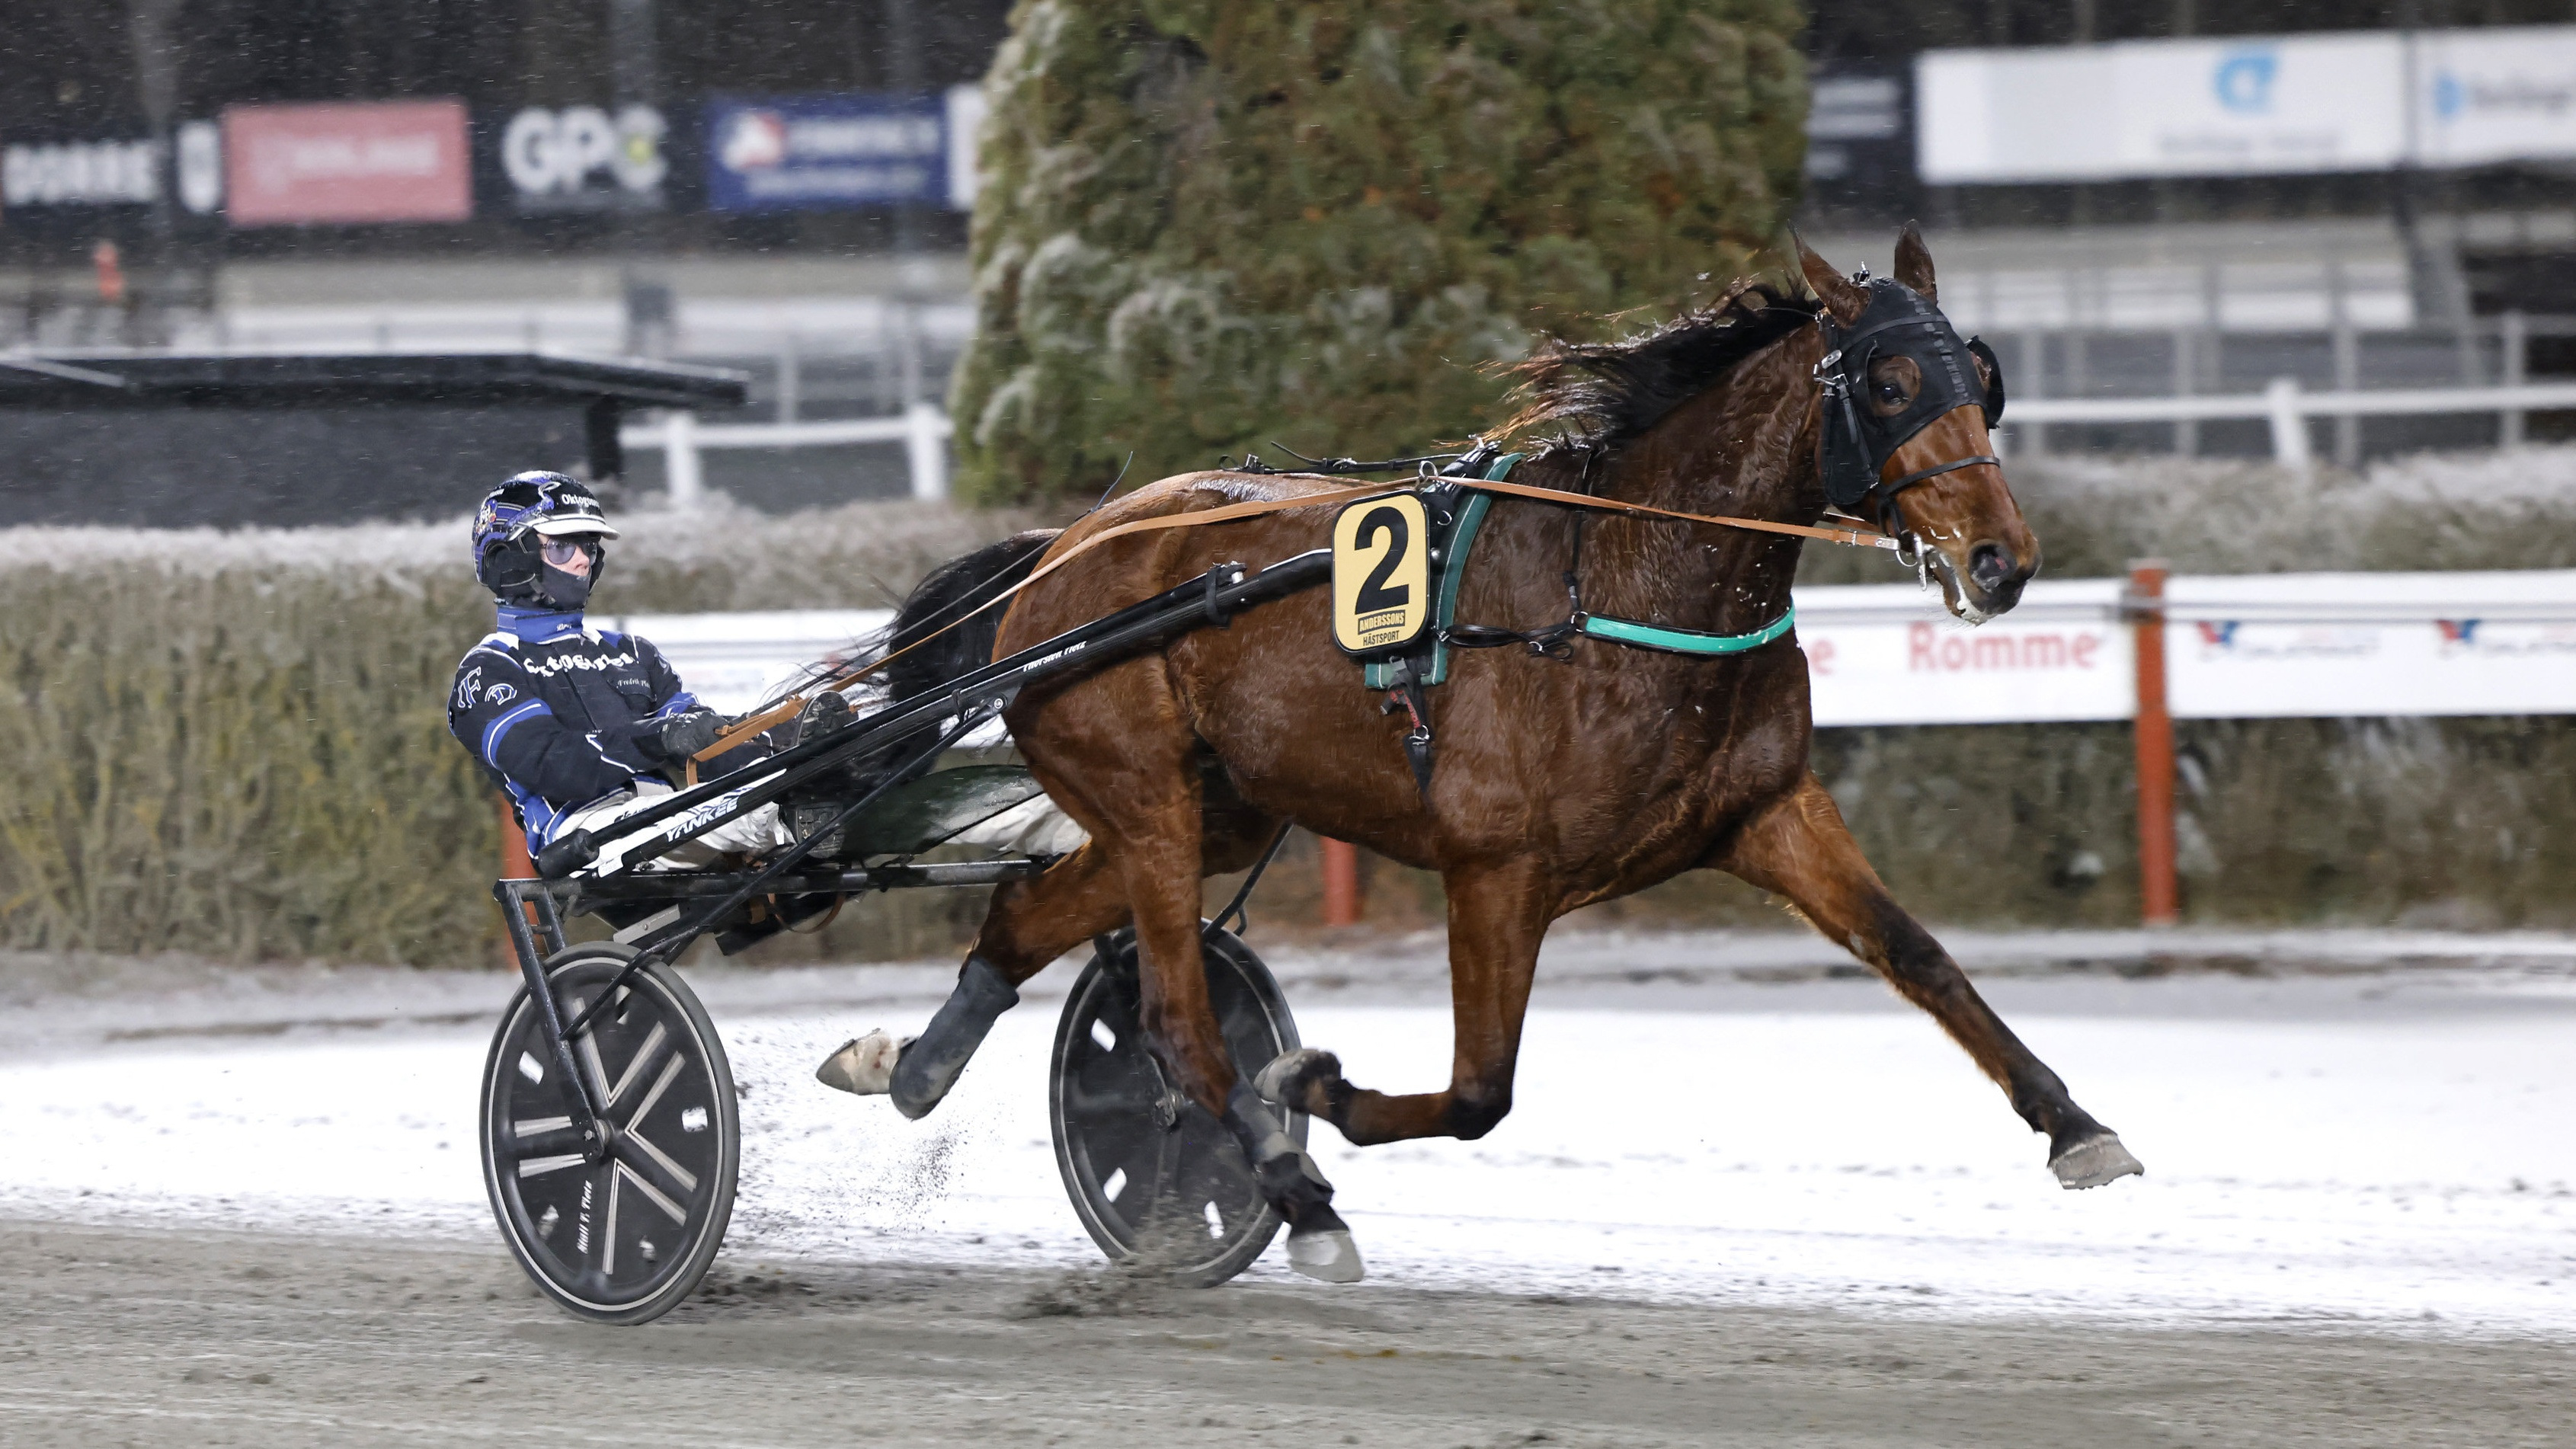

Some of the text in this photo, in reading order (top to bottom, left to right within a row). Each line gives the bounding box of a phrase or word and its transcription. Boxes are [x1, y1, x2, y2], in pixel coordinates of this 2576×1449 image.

[502, 105, 669, 193] GPC
[1354, 506, 1410, 616] 2
[1358, 612, 1405, 633] ANDERSSONS
[1362, 629, 1400, 647] HÄSTSPORT
[1909, 620, 2100, 672] Romme
[666, 796, 740, 843] YANKEE
